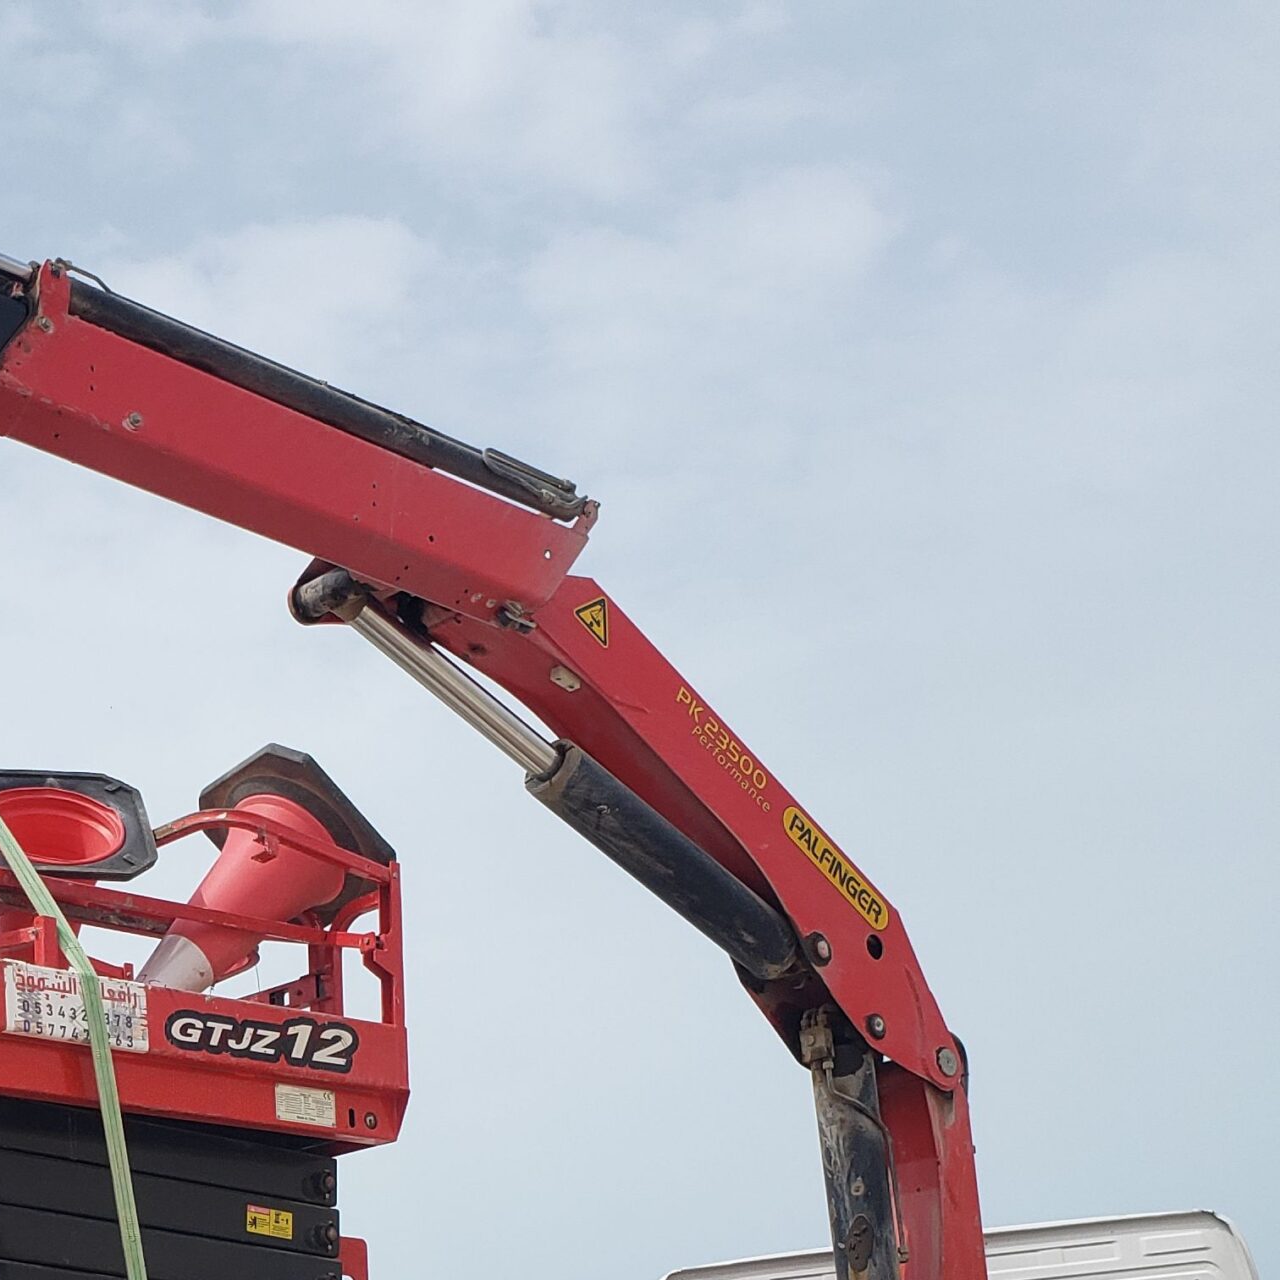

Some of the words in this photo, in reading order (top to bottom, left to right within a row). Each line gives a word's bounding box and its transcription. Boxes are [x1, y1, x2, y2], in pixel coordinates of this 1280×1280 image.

[676, 686, 705, 723] PK
[703, 716, 767, 789] 23500
[691, 725, 771, 813] Performance
[788, 813, 883, 925] PALFINGER
[22, 1000, 133, 1028] 053432378
[100, 982, 138, 1009] رافعا
